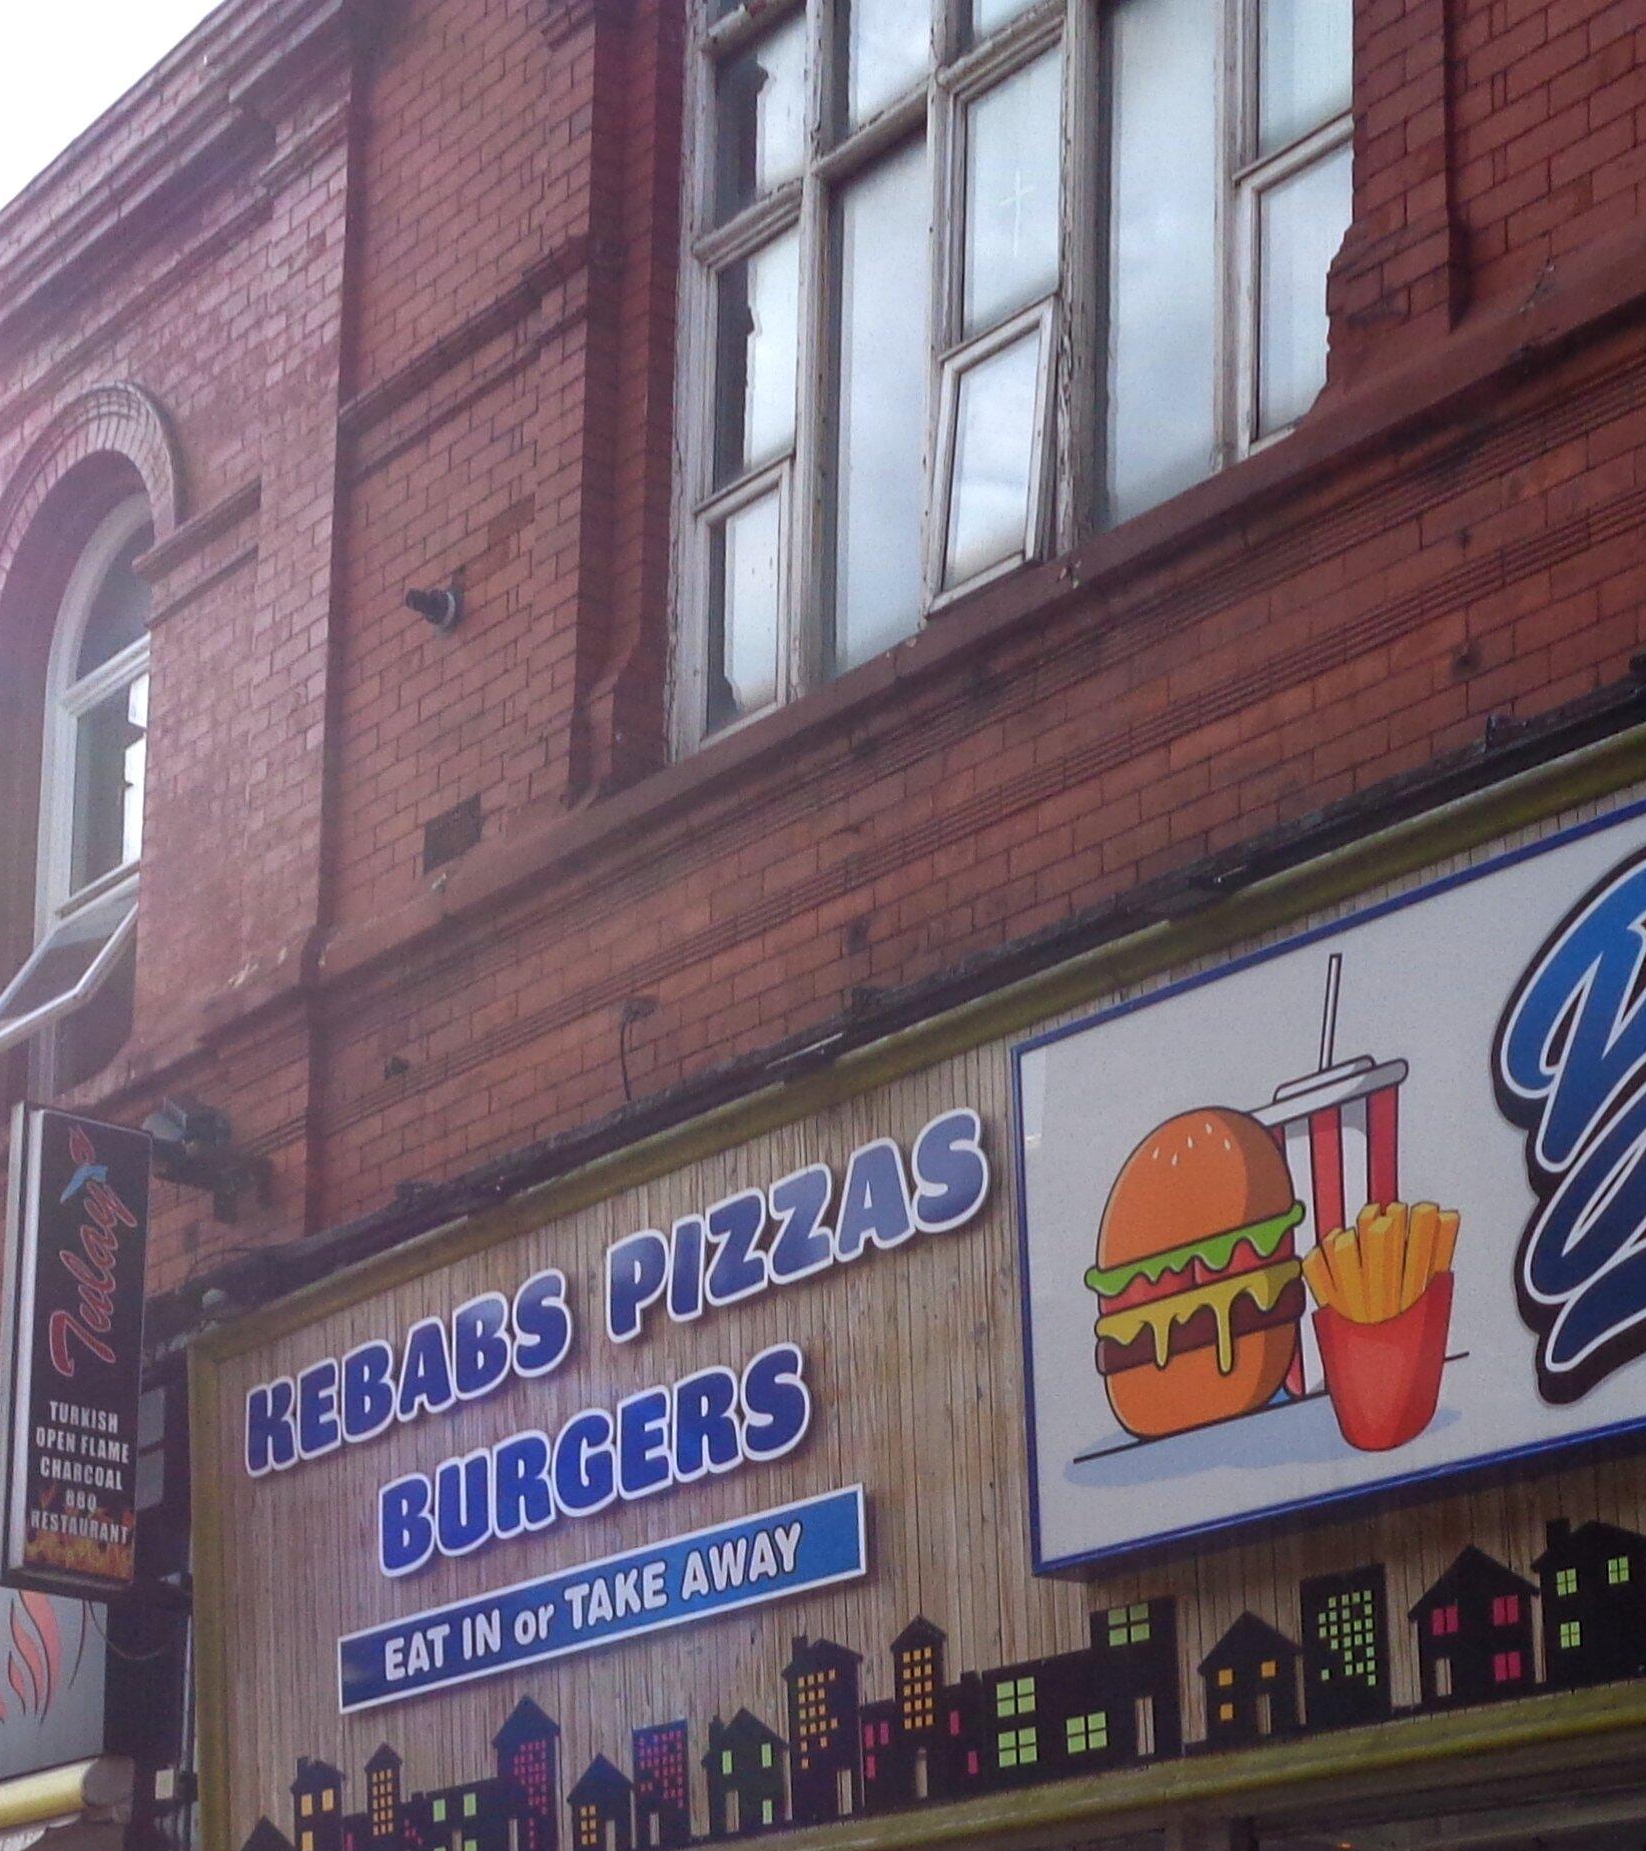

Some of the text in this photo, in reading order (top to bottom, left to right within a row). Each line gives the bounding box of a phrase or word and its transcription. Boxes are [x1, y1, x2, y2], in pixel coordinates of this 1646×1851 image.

[246, 1107, 991, 1478] KEBABS PIZZAS
[50, 1401, 118, 1434] TURKISH
[36, 1427, 130, 1465] OPEN FLAME
[378, 1342, 812, 1578] BURGERS
[40, 1456, 123, 1491] CHARCOAL
[65, 1489, 97, 1512] BBQ
[31, 1510, 129, 1545] RESTAURANT
[384, 1521, 805, 1682] EAT IN or TAKE AWAY
